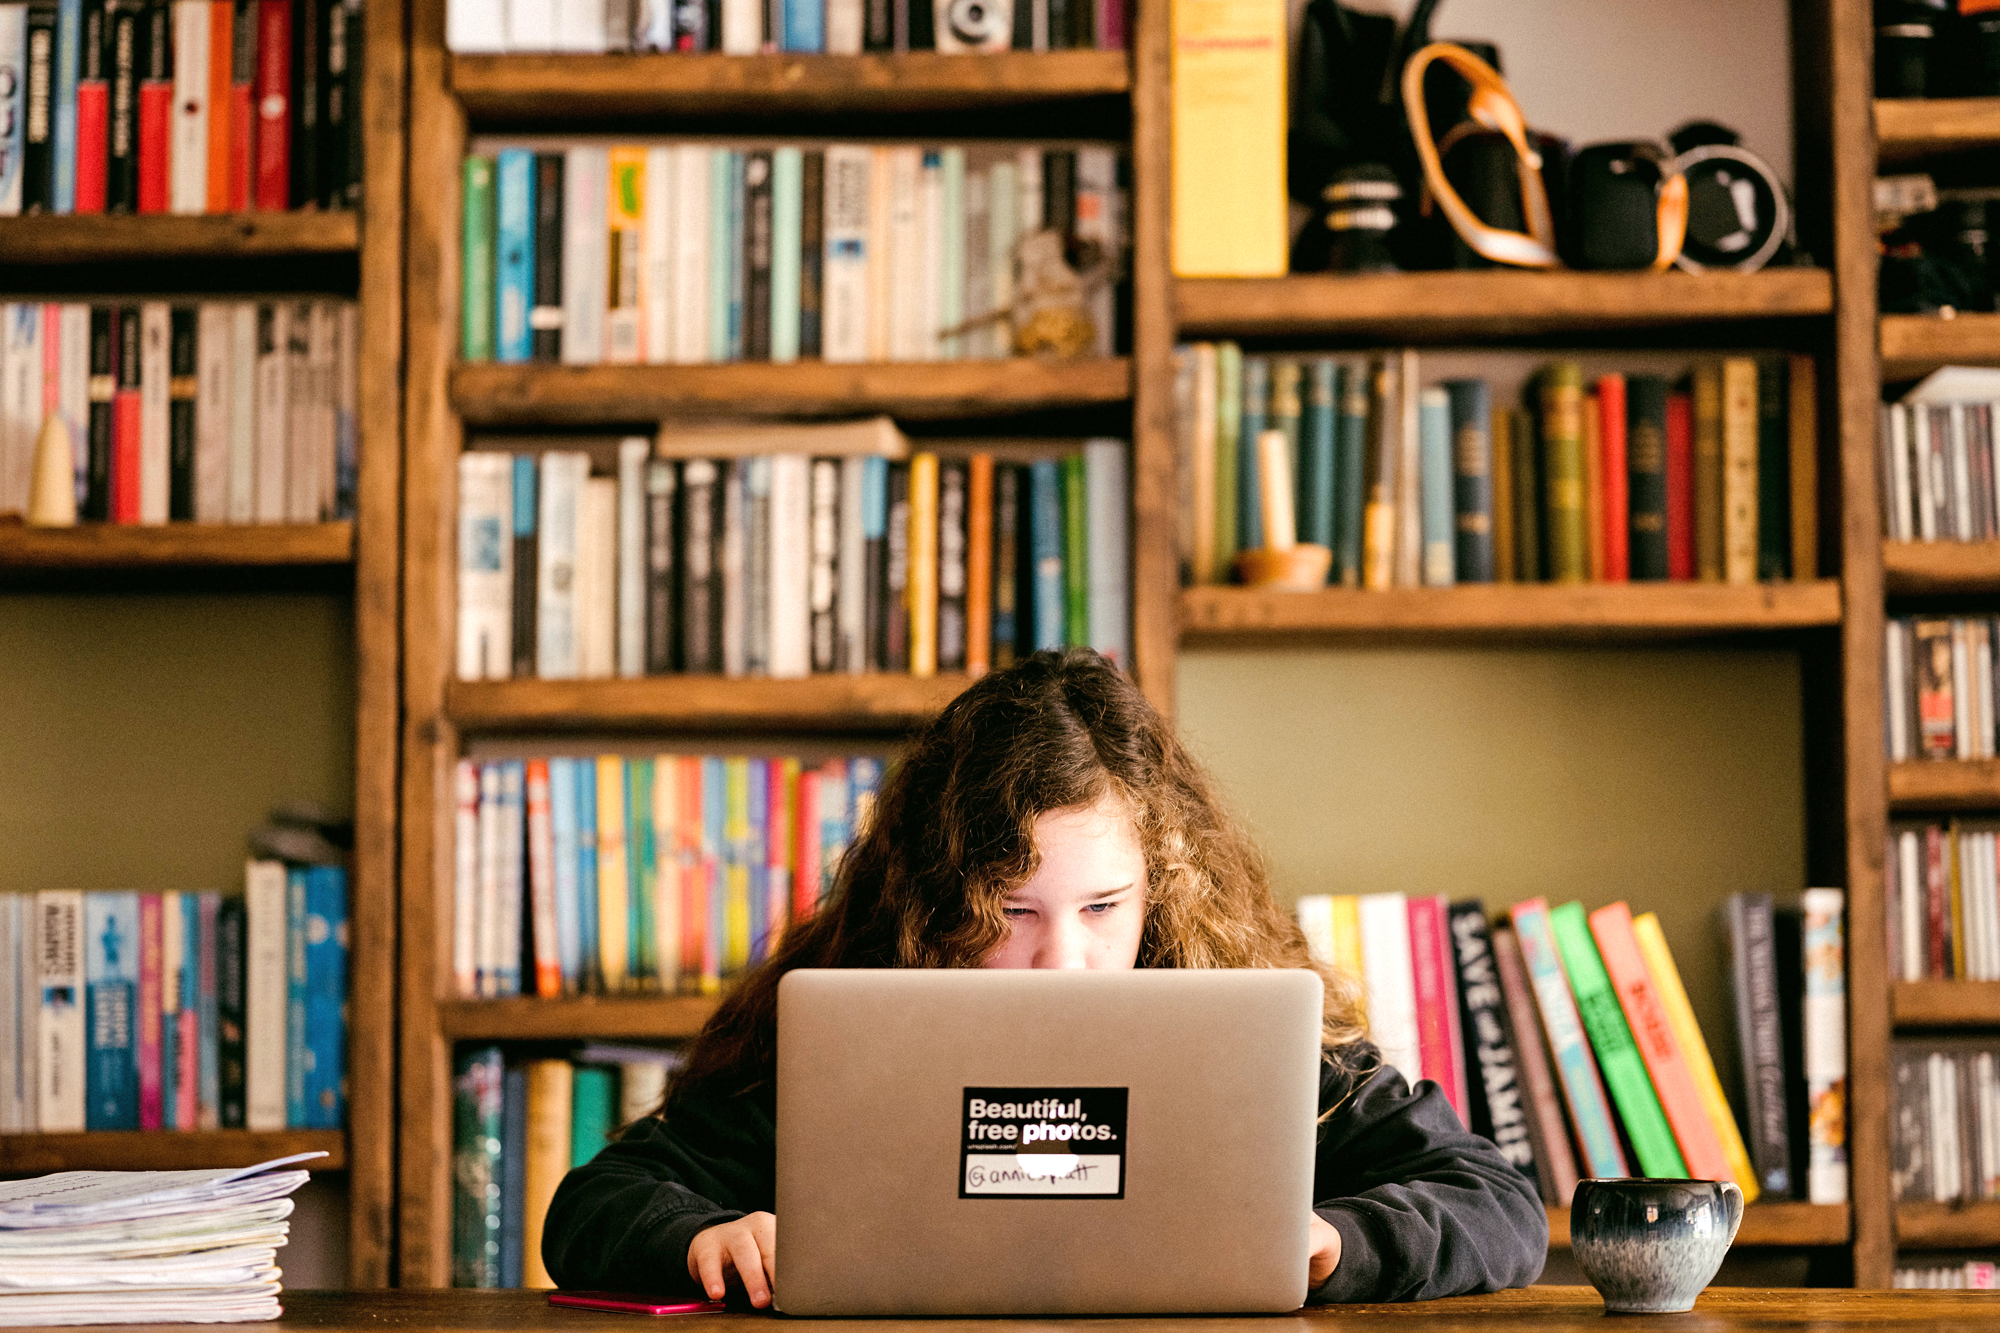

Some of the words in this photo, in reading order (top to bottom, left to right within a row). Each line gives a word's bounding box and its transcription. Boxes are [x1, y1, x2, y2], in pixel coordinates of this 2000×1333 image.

[969, 1098, 1087, 1122] Beautiful,
[968, 1120, 1018, 1140] free
[1022, 1120, 1117, 1144] photos.
